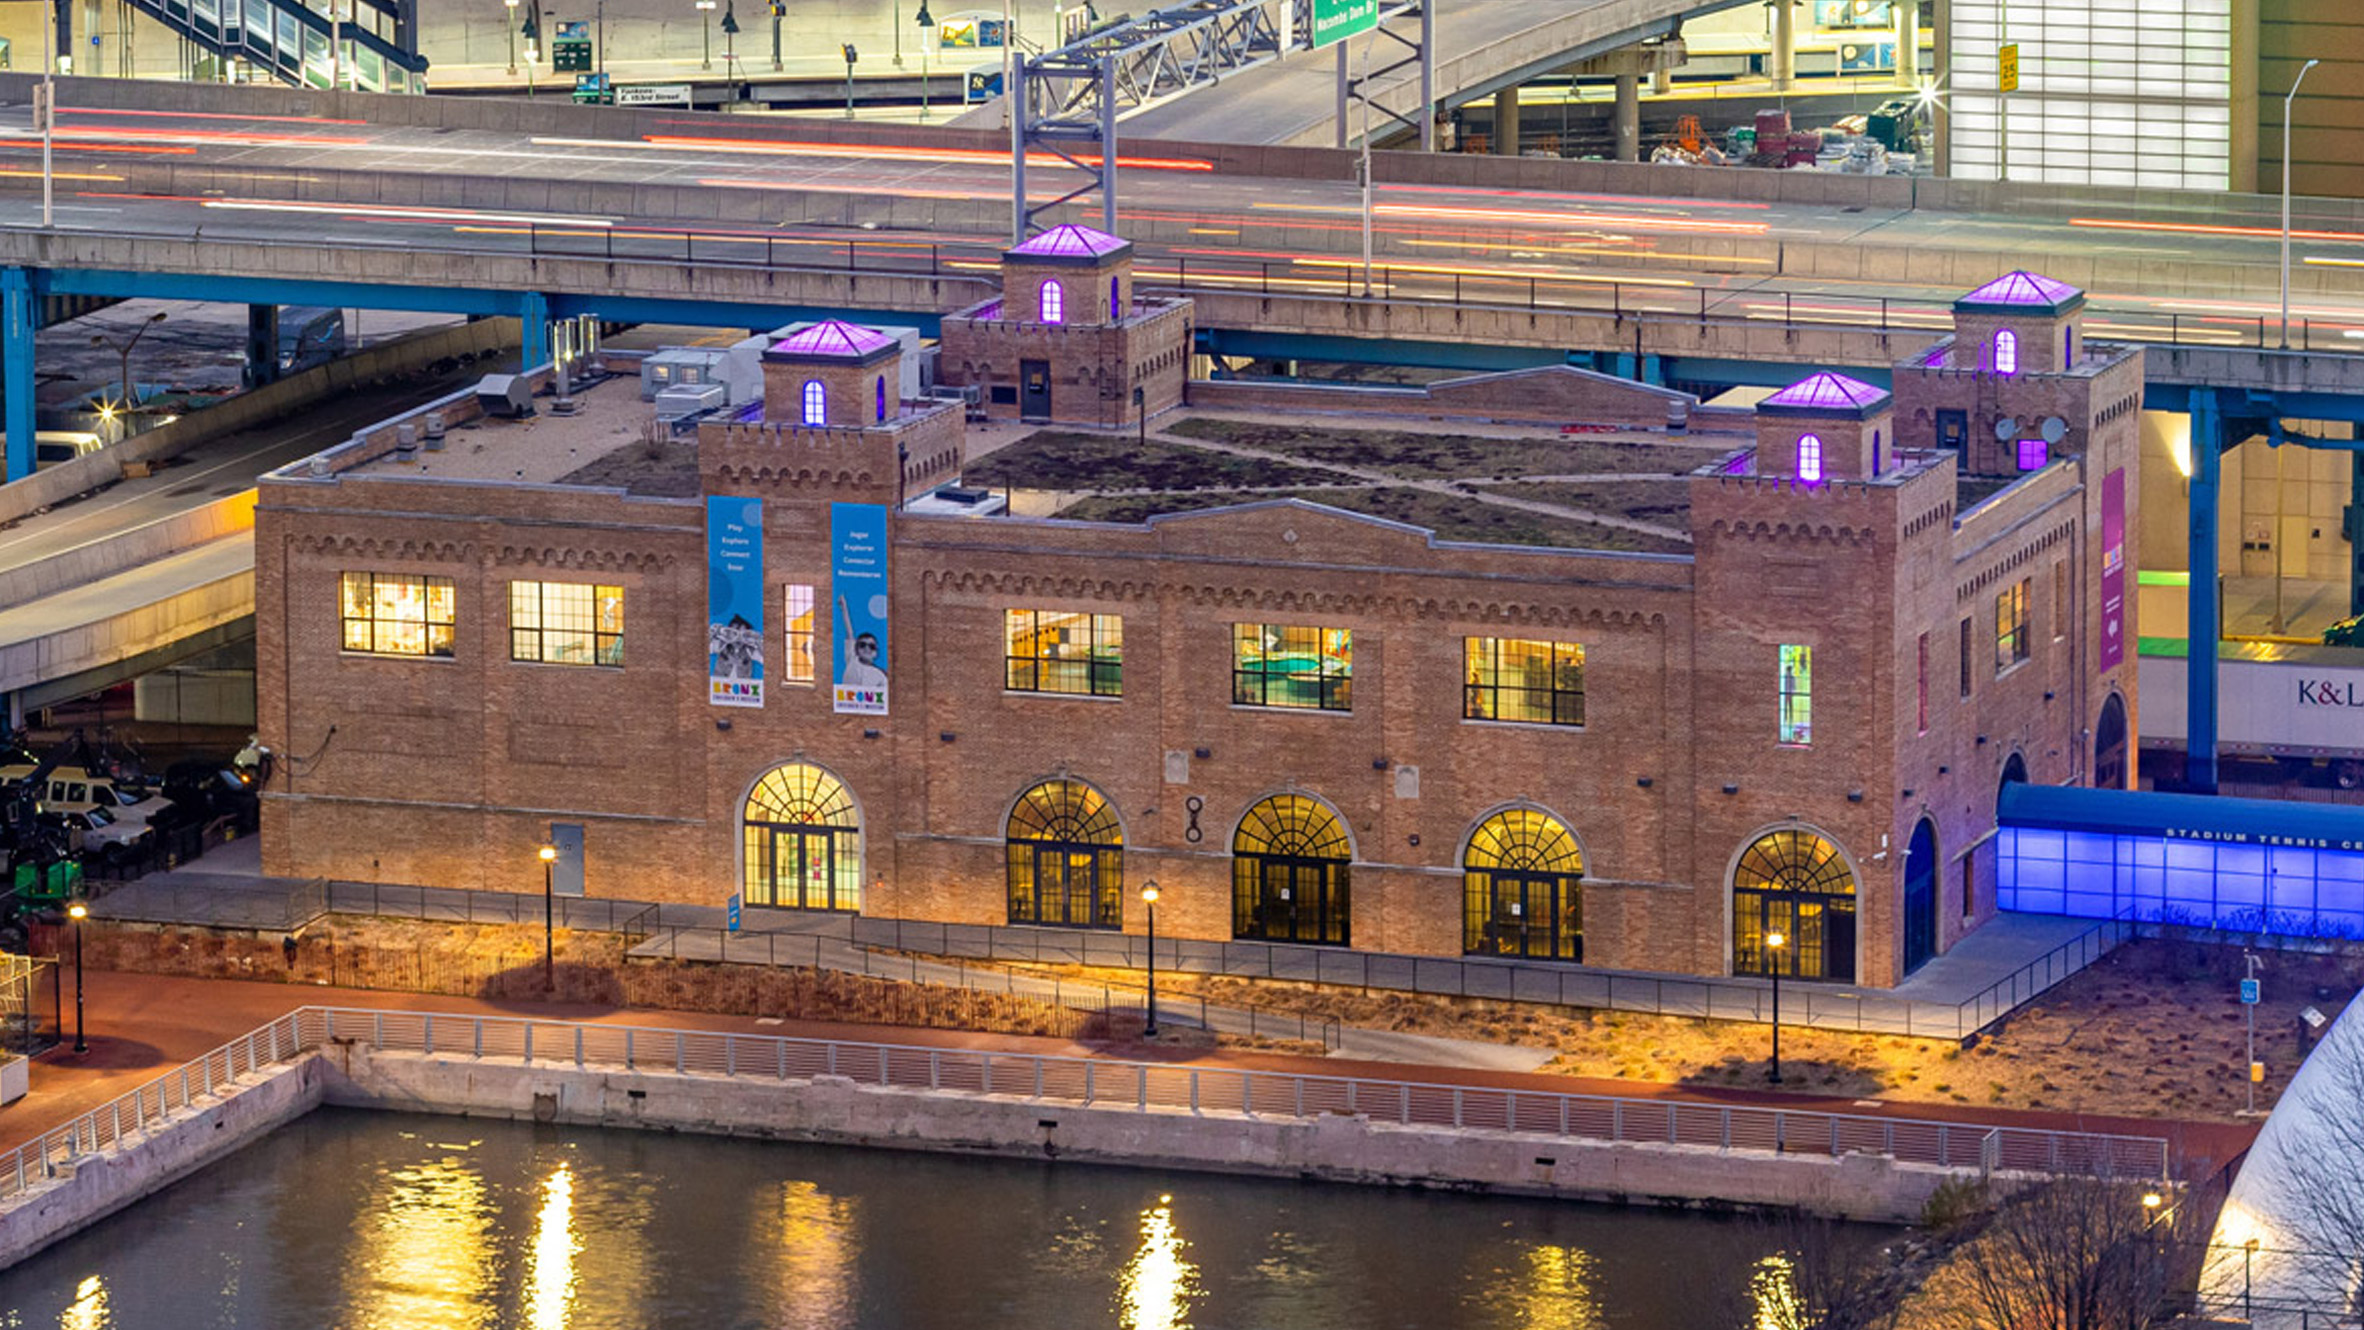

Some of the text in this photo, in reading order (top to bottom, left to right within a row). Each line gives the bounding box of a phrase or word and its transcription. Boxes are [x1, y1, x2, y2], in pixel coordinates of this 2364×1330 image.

[2003, 63, 2016, 79] 25
[655, 93, 680, 101] Street
[713, 681, 760, 697] BRONX
[836, 689, 884, 704] BRONX
[2299, 679, 2364, 707] K&L
[2166, 828, 2247, 842] STADIUM
[2258, 835, 2328, 848] TENNIS
